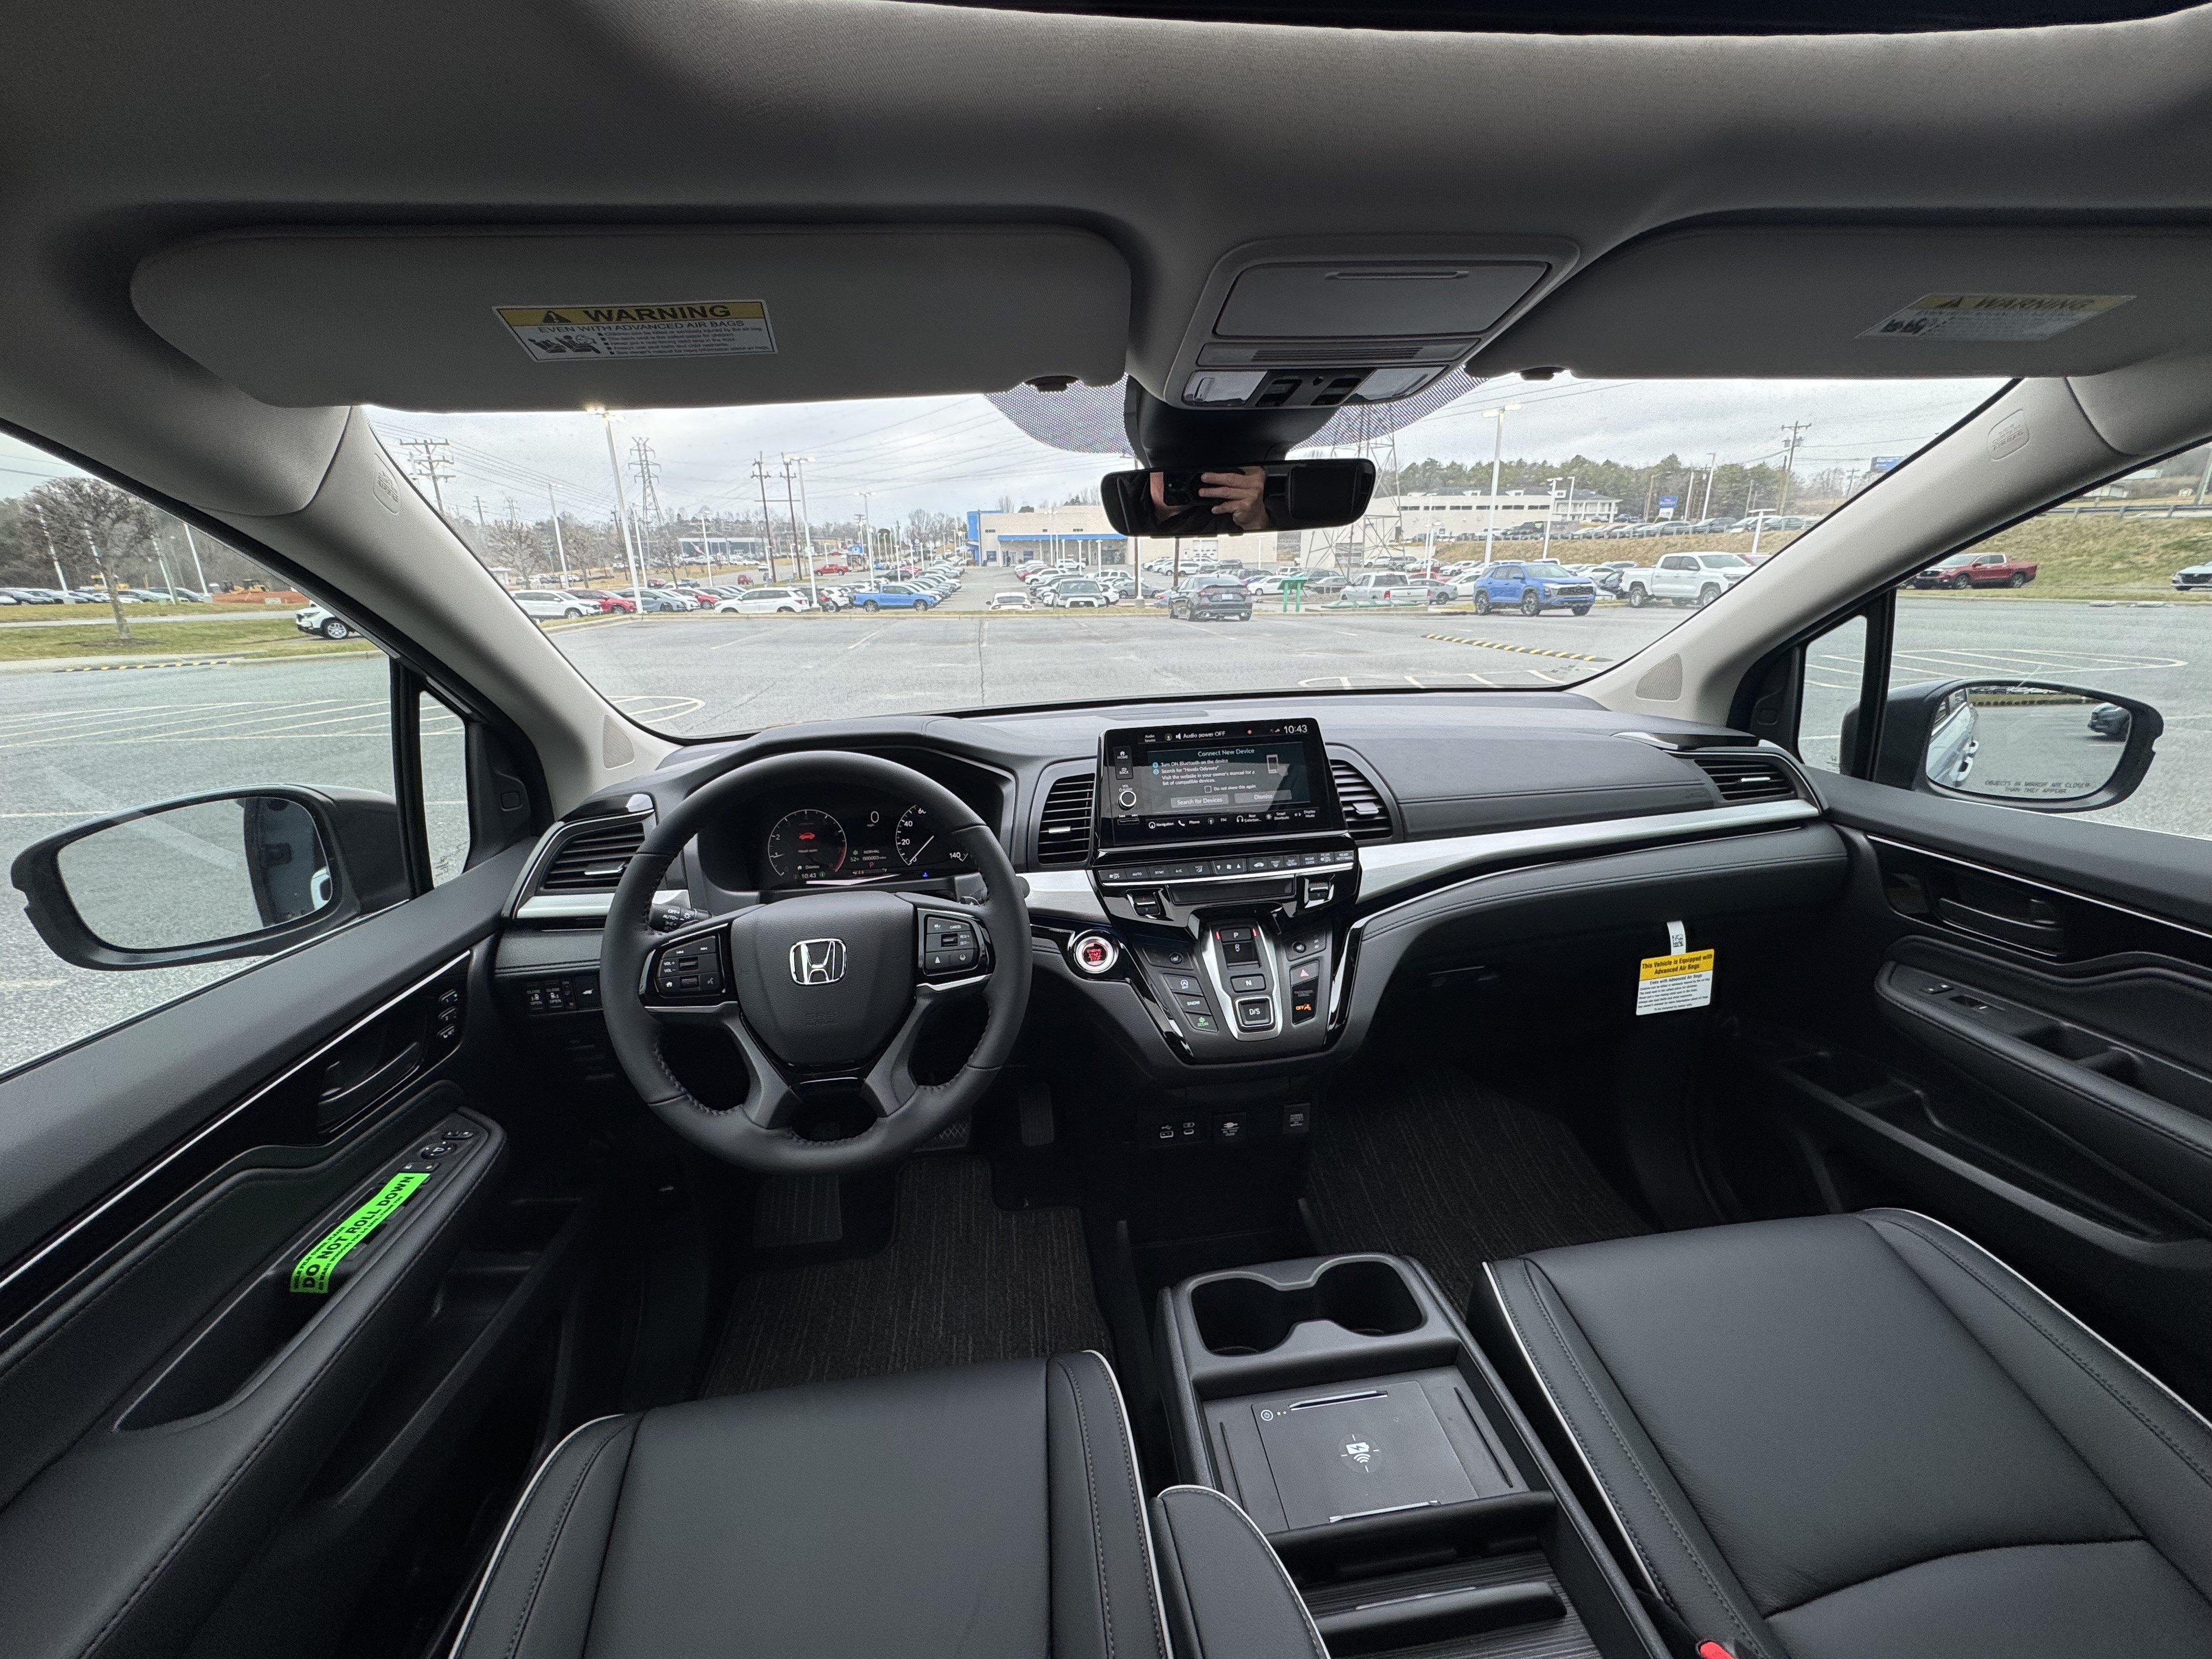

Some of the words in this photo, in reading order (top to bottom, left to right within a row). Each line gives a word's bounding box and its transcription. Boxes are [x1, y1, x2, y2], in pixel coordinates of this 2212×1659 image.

[583, 304, 731, 322] WARNING
[615, 322, 684, 331] ADVANCED
[1283, 725, 1307, 734] 10:43
[871, 811, 879, 823] 0
[1679, 955, 1701, 964] Equipped
[1654, 966, 1678, 975] Advanced
[302, 1264, 321, 1288] DO
[315, 1237, 349, 1259] NOT
[345, 1209, 382, 1234] ROLL
[376, 1176, 415, 1206] DOWN
